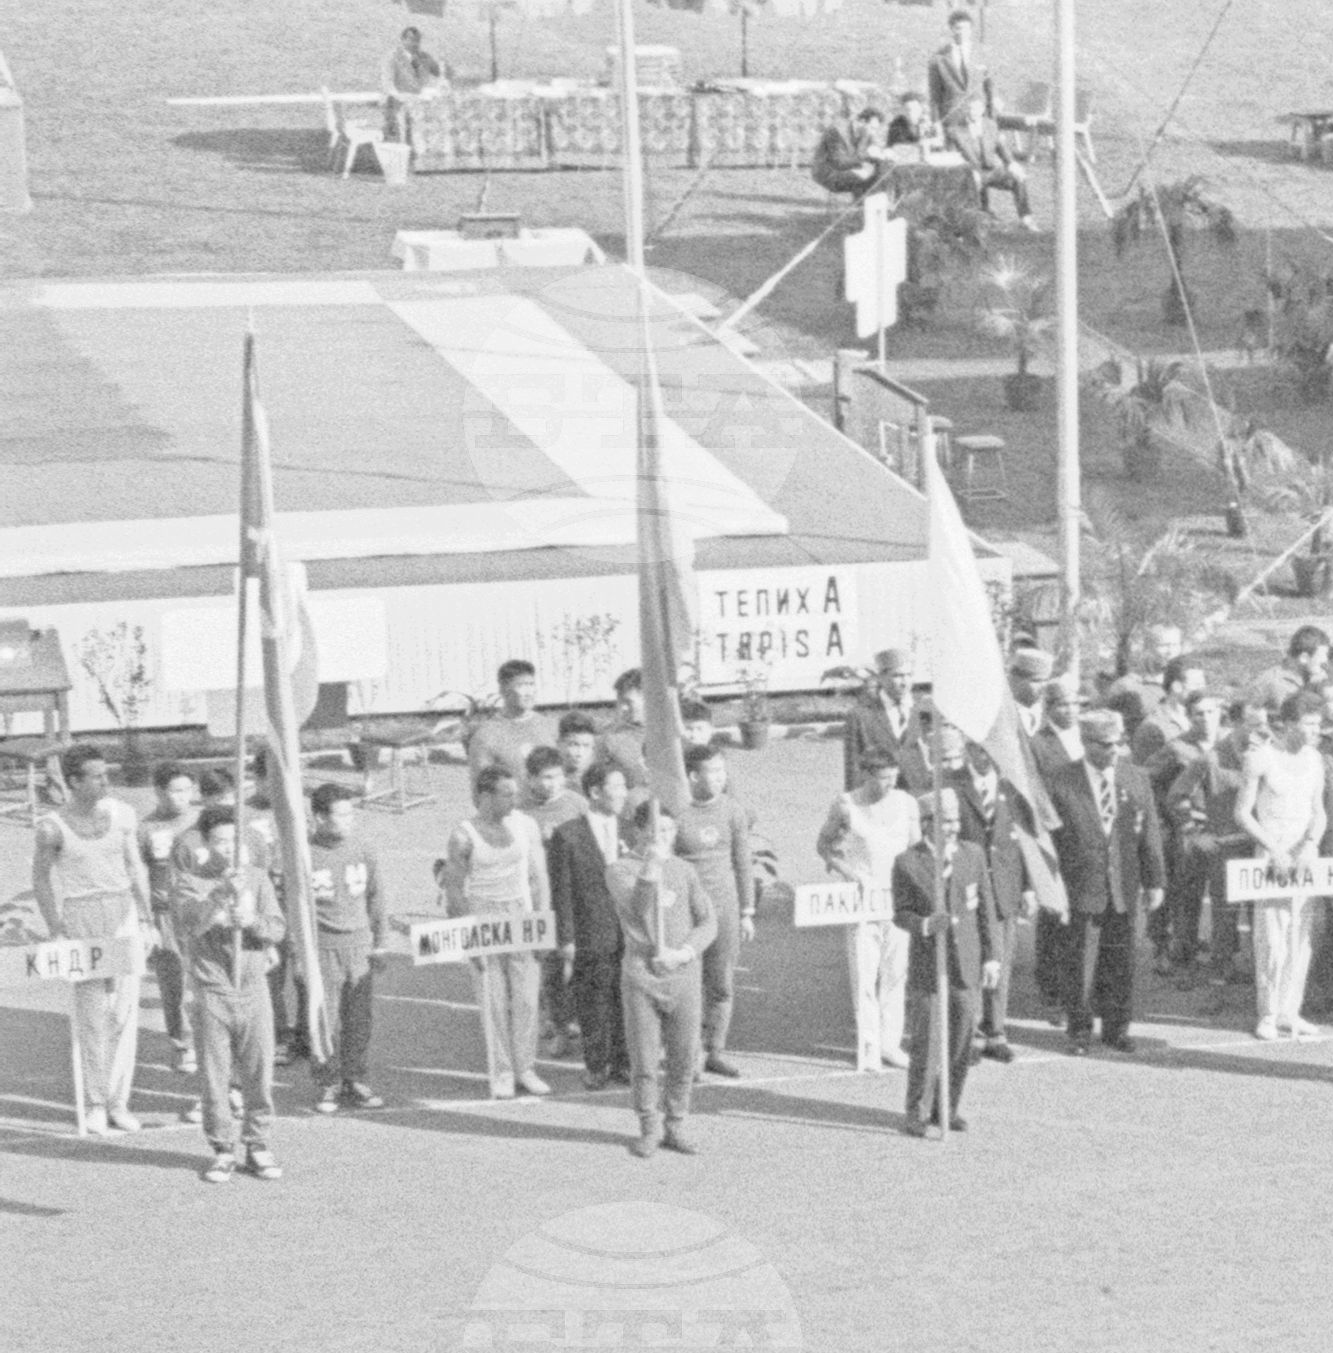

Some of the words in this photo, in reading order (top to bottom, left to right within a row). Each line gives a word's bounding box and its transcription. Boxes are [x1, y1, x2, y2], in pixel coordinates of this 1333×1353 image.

[715, 588, 810, 617] ТЕПИХ
[824, 575, 841, 613] А
[716, 629, 810, 662] TAPIS
[826, 621, 844, 657] A
[418, 921, 513, 957] МОНГОЛСКА
[522, 918, 547, 944] НР
[25, 946, 103, 978] КНДР
